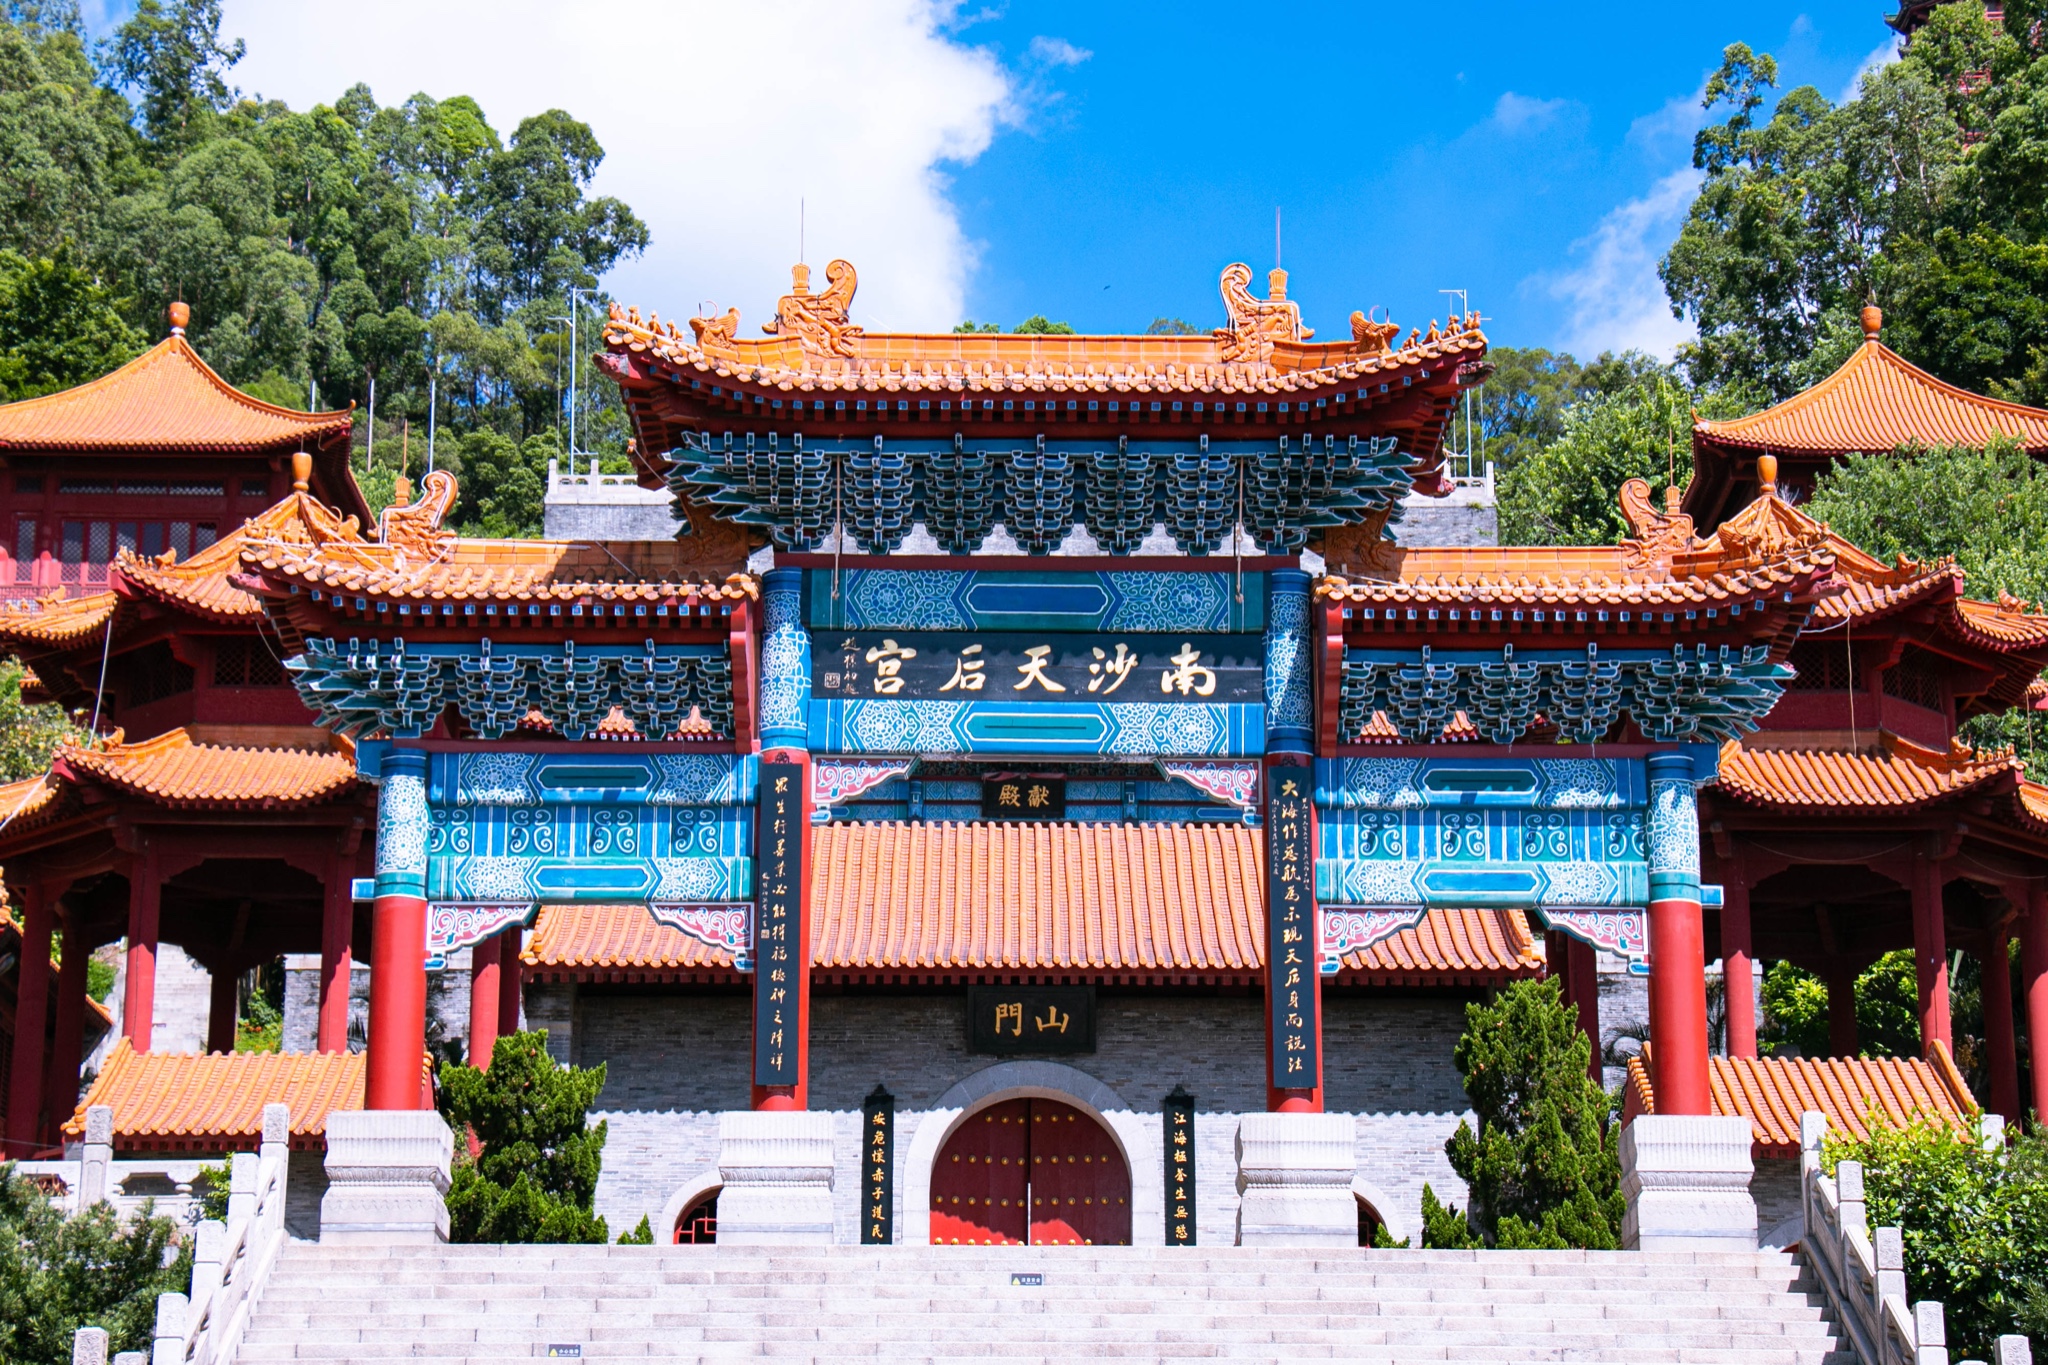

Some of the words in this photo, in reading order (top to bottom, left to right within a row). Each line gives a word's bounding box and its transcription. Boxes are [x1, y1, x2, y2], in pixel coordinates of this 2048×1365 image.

[865, 638, 1216, 697] 南沙天后宮
[998, 784, 1051, 808] 獻殿
[995, 1002, 1070, 1037] 山門
[871, 1111, 887, 1244] 安危懷赤子護民
